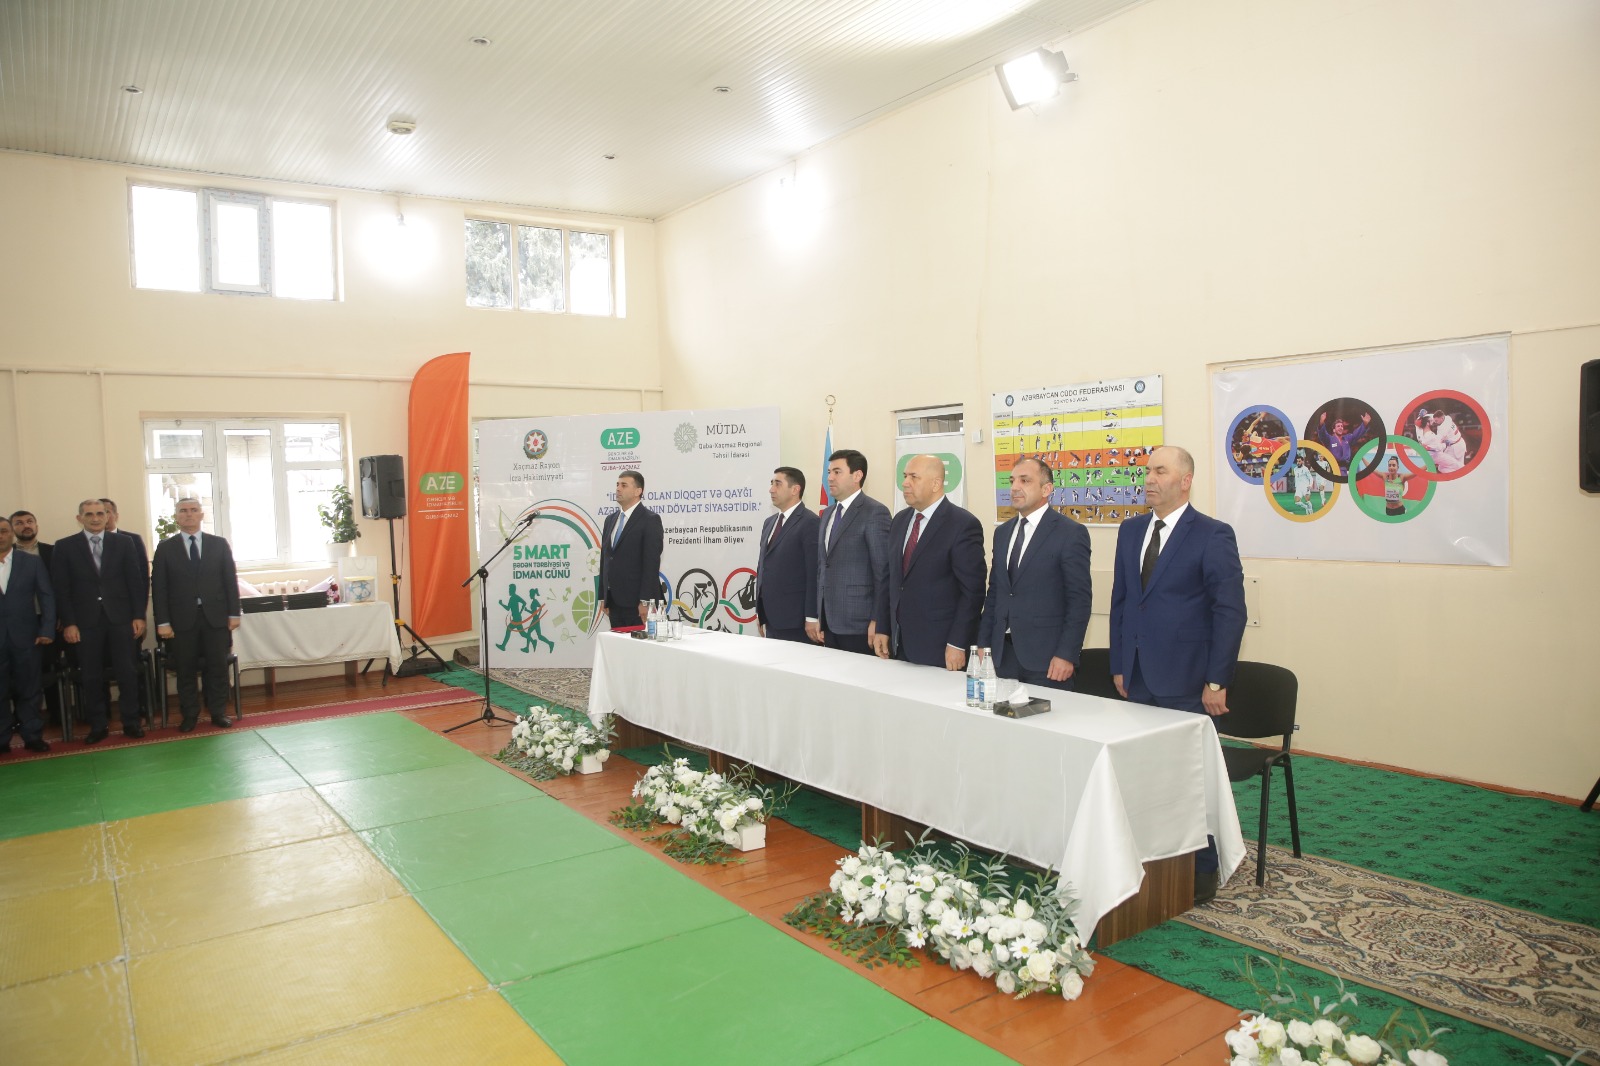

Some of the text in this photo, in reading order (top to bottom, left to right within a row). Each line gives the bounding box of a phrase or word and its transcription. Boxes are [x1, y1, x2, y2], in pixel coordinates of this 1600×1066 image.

[706, 423, 746, 435] MÜTDA
[607, 431, 634, 446] AZE
[539, 461, 560, 471] Rayon
[426, 475, 456, 491] AZE
[647, 491, 672, 501] OLAN
[674, 489, 708, 501] DİQQƏT
[709, 489, 722, 499] VƏ
[724, 487, 752, 499] QAYĞI
[667, 502, 702, 514] DÖVLƏT
[663, 524, 753, 535] zərbaycan Respublikasının
[668, 535, 745, 545] Prezidenti İlham Əliyev
[513, 544, 571, 560] 5 MART
[512, 567, 571, 579] İDMAN GÜNÜ
